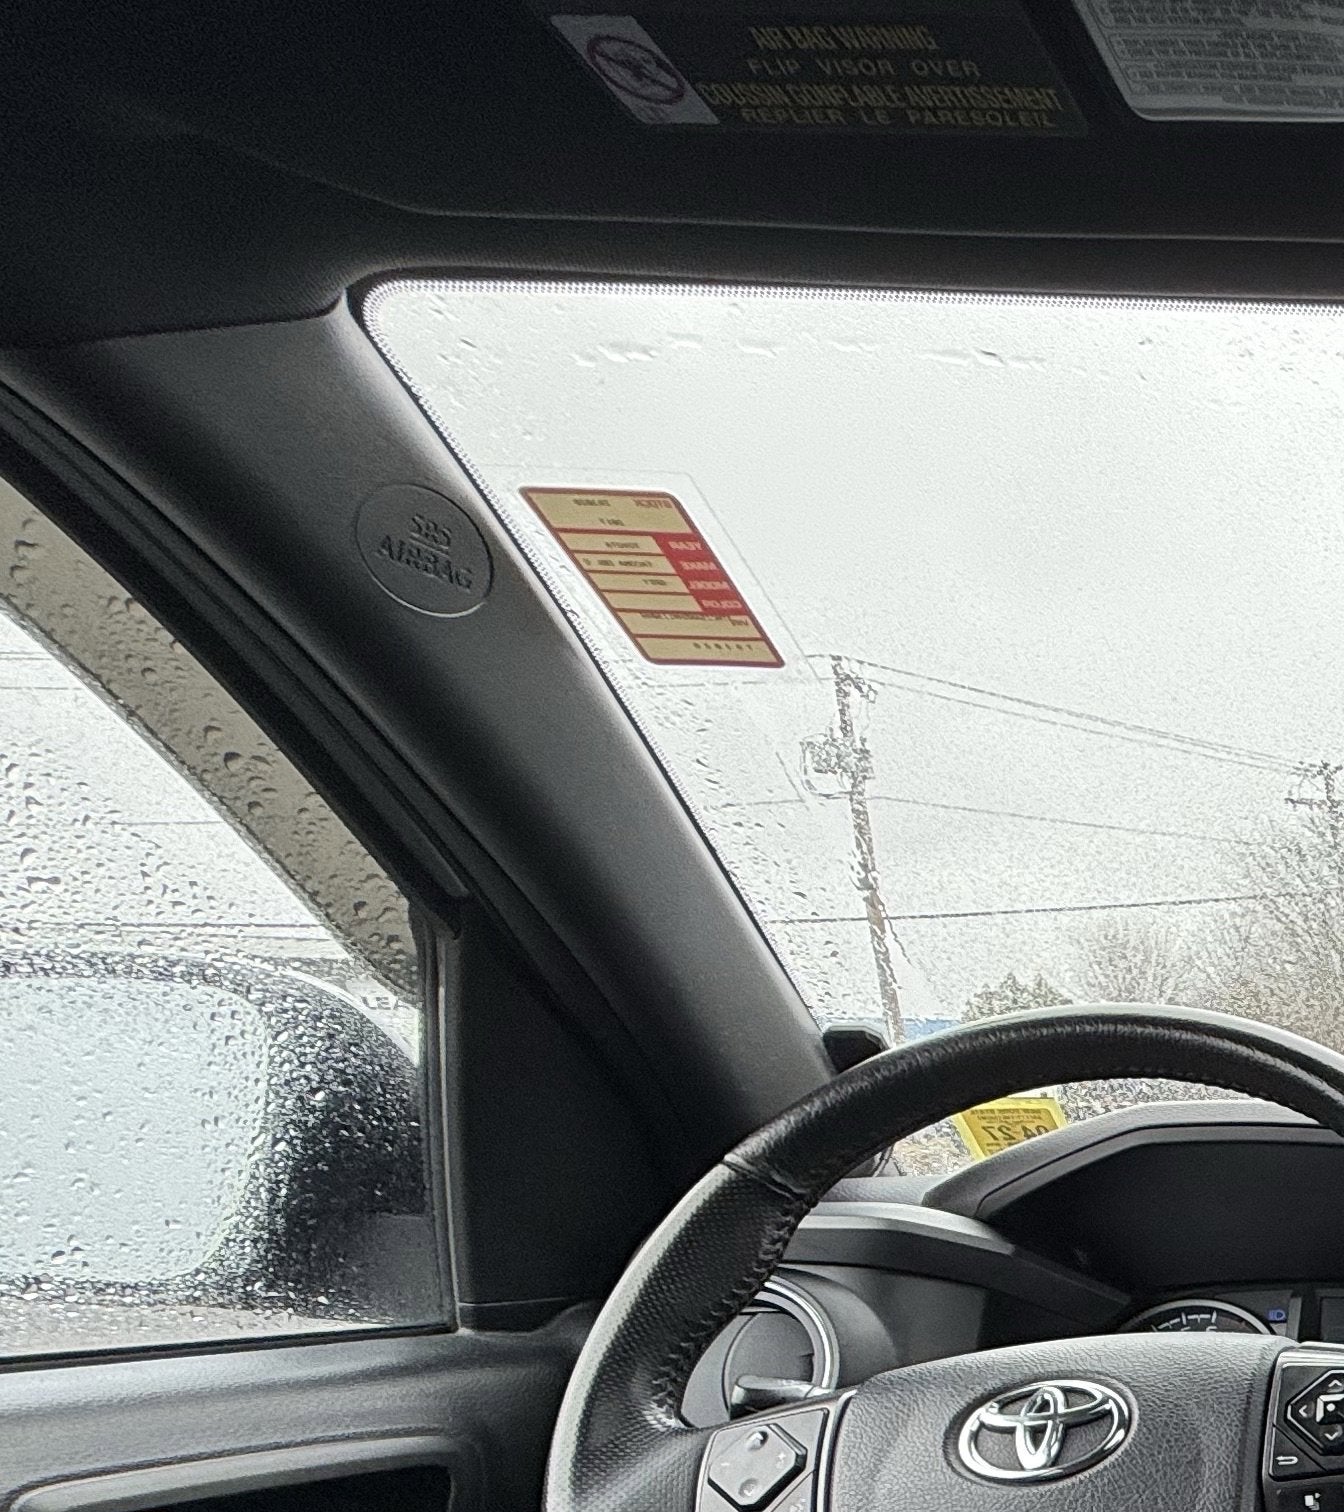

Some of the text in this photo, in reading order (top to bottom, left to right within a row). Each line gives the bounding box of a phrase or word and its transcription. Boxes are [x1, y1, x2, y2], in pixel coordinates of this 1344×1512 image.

[747, 57, 981, 78] FLIP VISOR OVER
[740, 107, 1056, 128] REPLIER LE PARESOLEIL
[375, 535, 474, 594] AIRBAG
